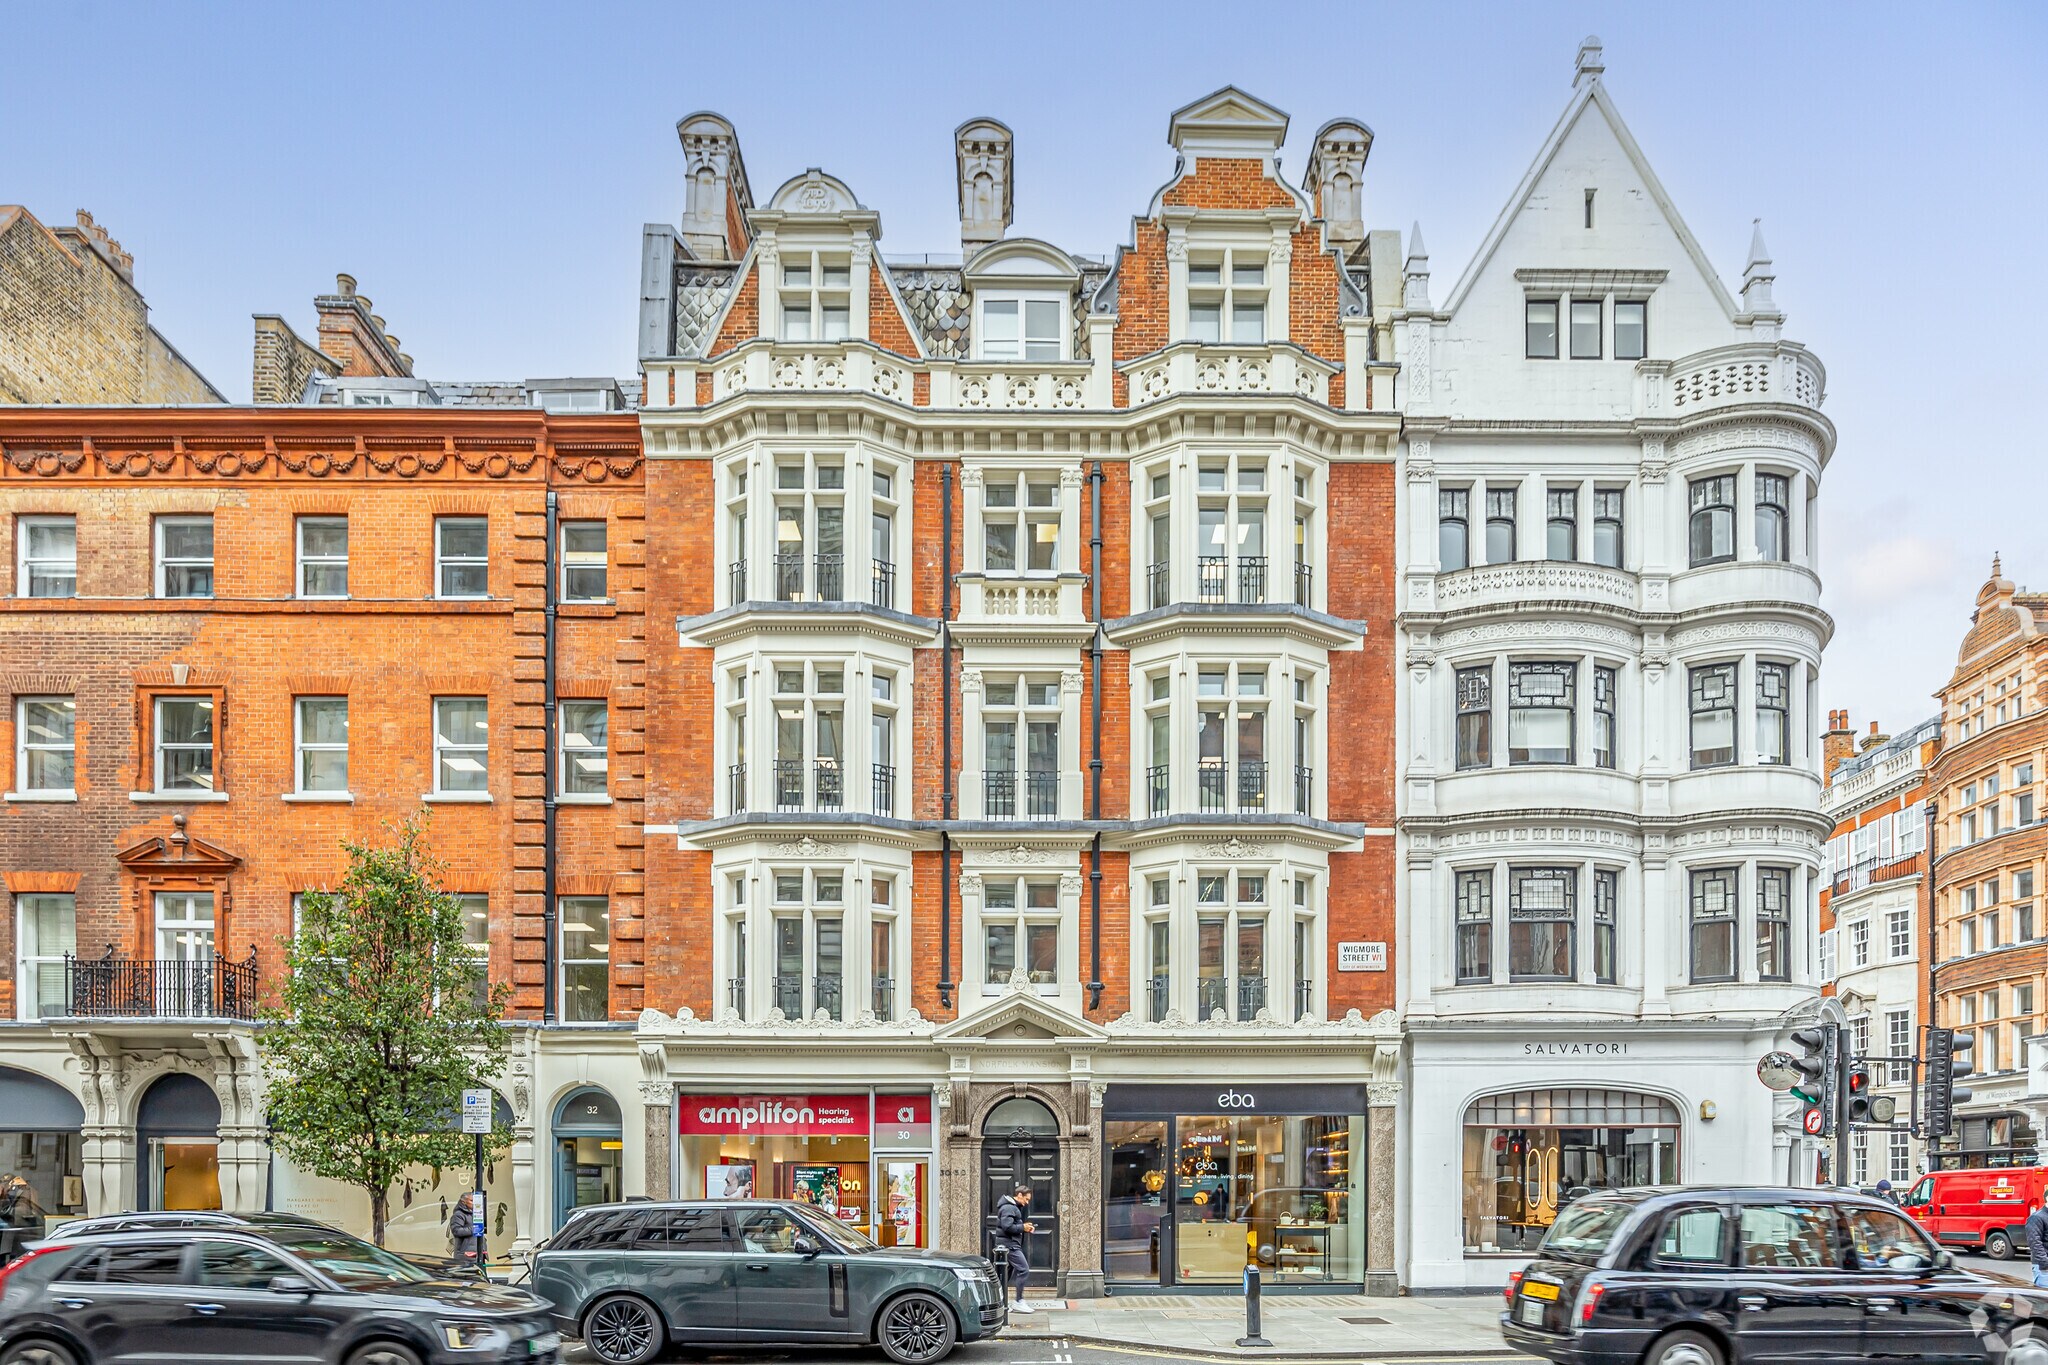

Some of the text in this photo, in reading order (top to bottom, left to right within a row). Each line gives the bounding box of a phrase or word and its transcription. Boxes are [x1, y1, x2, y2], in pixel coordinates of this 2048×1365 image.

[1343, 945, 1380, 953] WIGMORE
[1524, 1043, 1627, 1055] SALVATORI
[978, 1060, 1018, 1069] NORFOLK
[2008, 1089, 2020, 1097] Street
[1218, 1089, 1255, 1108] eba
[586, 1105, 598, 1114] 32
[818, 1107, 849, 1117] Hearing
[699, 1101, 815, 1129] amplifon
[897, 1107, 914, 1123] a
[818, 1116, 854, 1125] specialist
[897, 1131, 910, 1140] 30
[1195, 1159, 1218, 1171] eba
[840, 1177, 861, 1191] on
